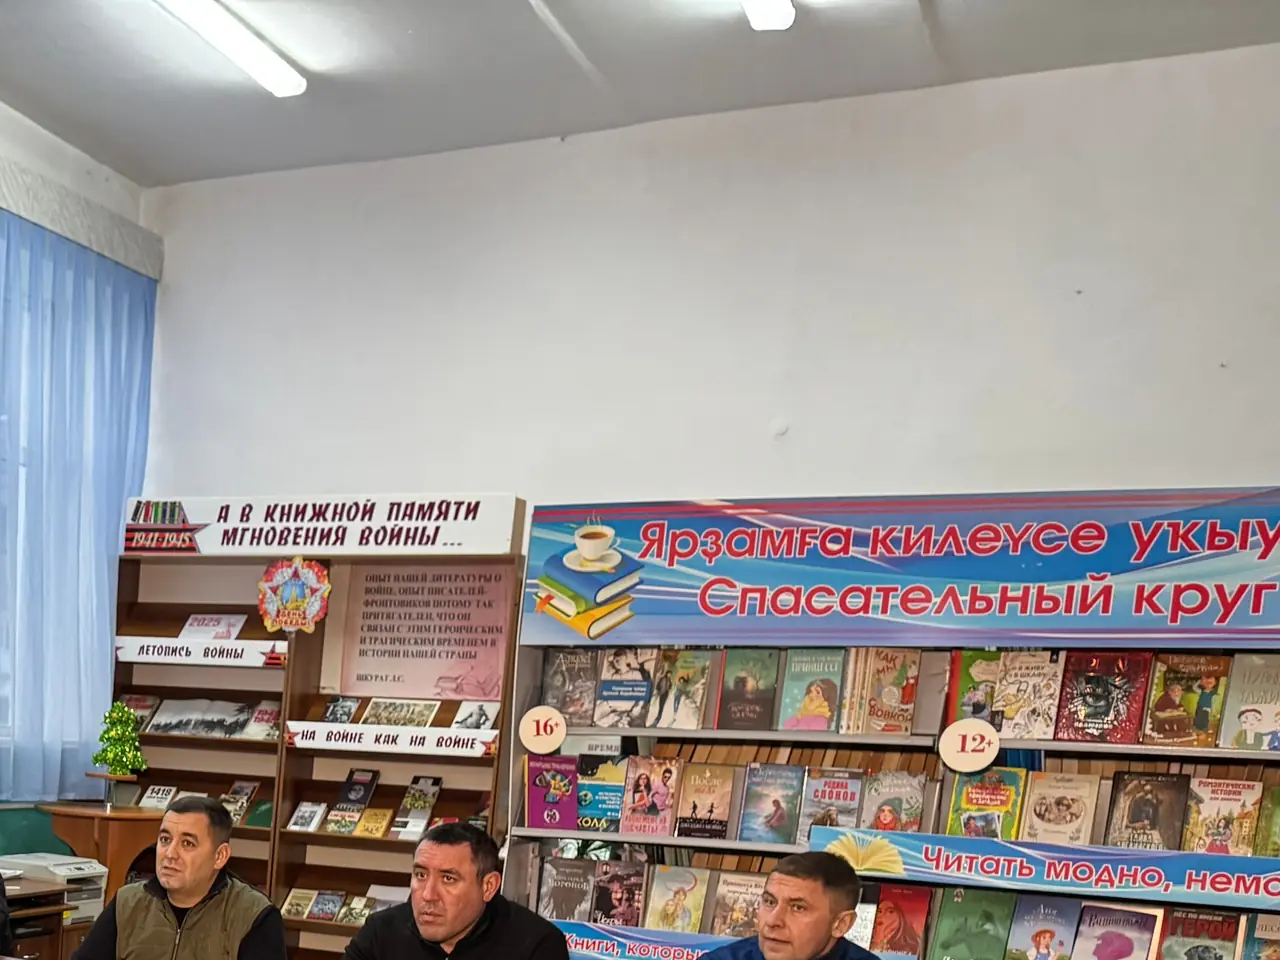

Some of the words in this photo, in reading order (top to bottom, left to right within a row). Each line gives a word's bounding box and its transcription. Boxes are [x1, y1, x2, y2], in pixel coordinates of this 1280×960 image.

[216, 504, 230, 523] А
[239, 504, 254, 522] В
[264, 498, 377, 523] КНИЖНОЙ
[386, 500, 481, 522] ПАМЯТИ
[131, 531, 191, 548] 1941-1945
[220, 525, 348, 546] МГНОВЕНИЯ
[365, 574, 391, 582] ОПЫТ
[394, 572, 428, 583] НАШЕЙ
[429, 573, 493, 583] ЛИТЕРАТУРЫ
[398, 586, 425, 596] ОПЫТ
[363, 599, 431, 608] ФРОНТОВИКОВ
[432, 600, 472, 608] ПОТОМУ
[476, 600, 494, 608] ТАК
[698, 572, 1113, 616] Спасательный
[1132, 582, 1278, 626] круг
[279, 609, 304, 618] ДЕНЬ
[436, 612, 455, 620] ЧТО
[456, 612, 471, 621] ОН
[360, 624, 396, 634] СВЯЗАН
[406, 624, 432, 634] ЭТИМ
[433, 624, 503, 634] ГЕРОИЧЕСКИМ
[368, 636, 435, 646] ТРАГИЧЕСКИМ
[436, 638, 488, 647] ВРЕМЕНЕМ
[138, 644, 192, 658] ЛЕТОПИСЬ
[203, 646, 245, 659] ВОЙНЫ
[359, 649, 400, 658] ИСТОРИИ
[402, 648, 436, 659] НАШЕЙ
[438, 650, 478, 660] СТРАНЫ
[874, 648, 900, 666] КАК
[876, 663, 898, 676] МЫ
[532, 716, 561, 738] 16+
[300, 730, 316, 740] НА
[326, 730, 364, 744] ВОЙНЕ
[374, 734, 399, 746] КАК
[409, 735, 426, 746] НА
[436, 734, 477, 750] ВОЙНЕ
[956, 733, 994, 754] 12+
[588, 743, 620, 752] ВРЕМЯ
[823, 780, 849, 790] РОДИНА
[1198, 780, 1256, 790] РОМАНТИЧЕСКИЕ
[150, 787, 173, 796] 1418
[813, 788, 857, 802] СЛОНОВ
[1210, 788, 1242, 797] ИСТОРИИ
[922, 846, 1035, 877] Читать
[1045, 860, 1172, 893] модно,
[1200, 914, 1224, 922] ИМЕНИ
[1171, 915, 1237, 942] ГЕРОЙ
[564, 932, 621, 956] Книги,
